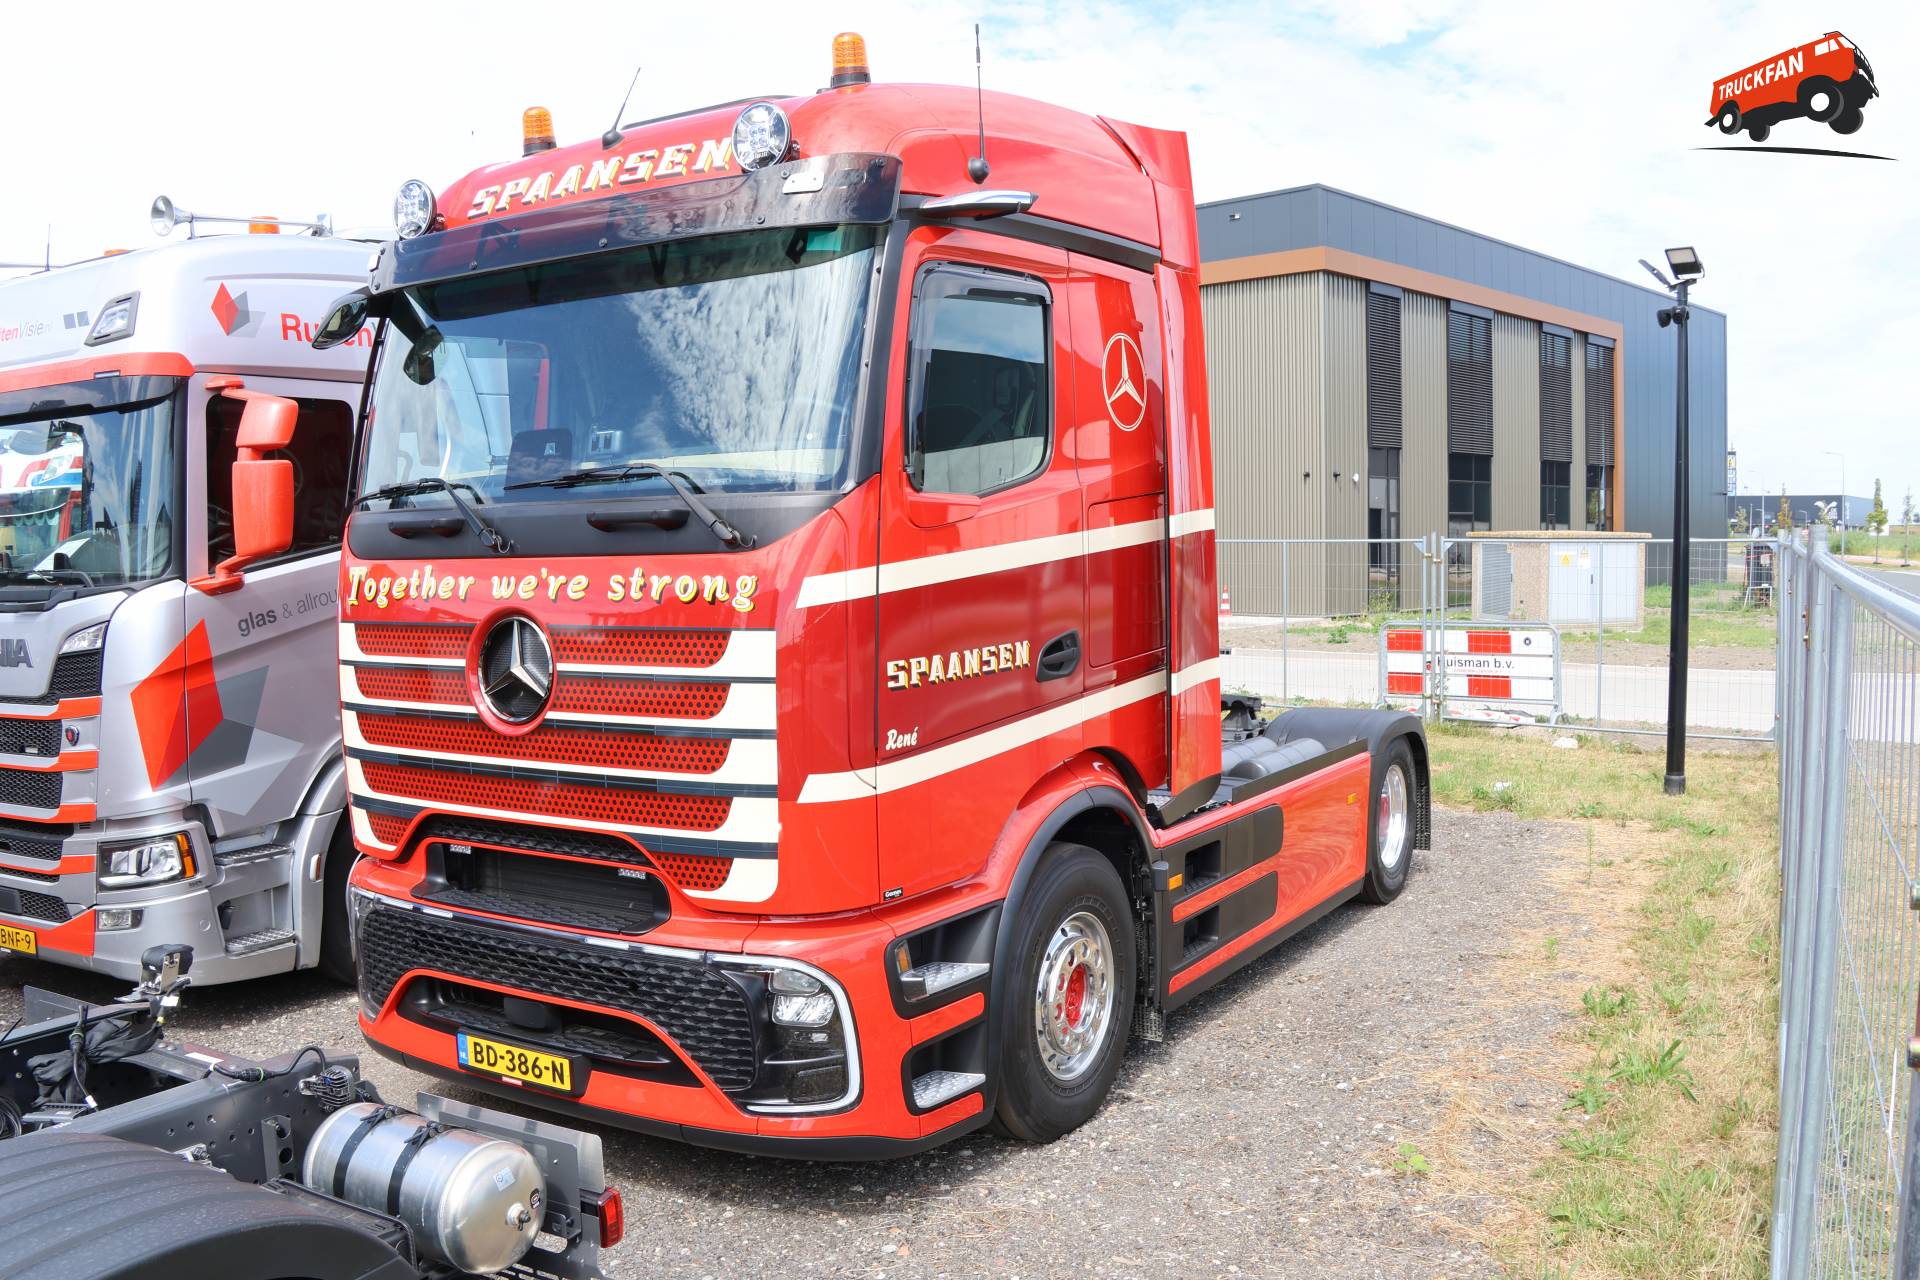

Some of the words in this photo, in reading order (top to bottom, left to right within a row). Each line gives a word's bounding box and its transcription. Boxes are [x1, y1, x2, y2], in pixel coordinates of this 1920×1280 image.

[467, 136, 734, 220] SPAANSEN
[348, 564, 475, 608] Together
[491, 567, 589, 602] we're
[607, 567, 758, 612] strong
[238, 609, 277, 637] glas
[282, 602, 293, 619] &
[886, 640, 1031, 692] SPAANSEN
[1494, 658, 1515, 669] b.v.
[885, 726, 919, 751] René
[0, 928, 31, 950] BNF-9
[472, 1041, 566, 1086] BD-386-N
